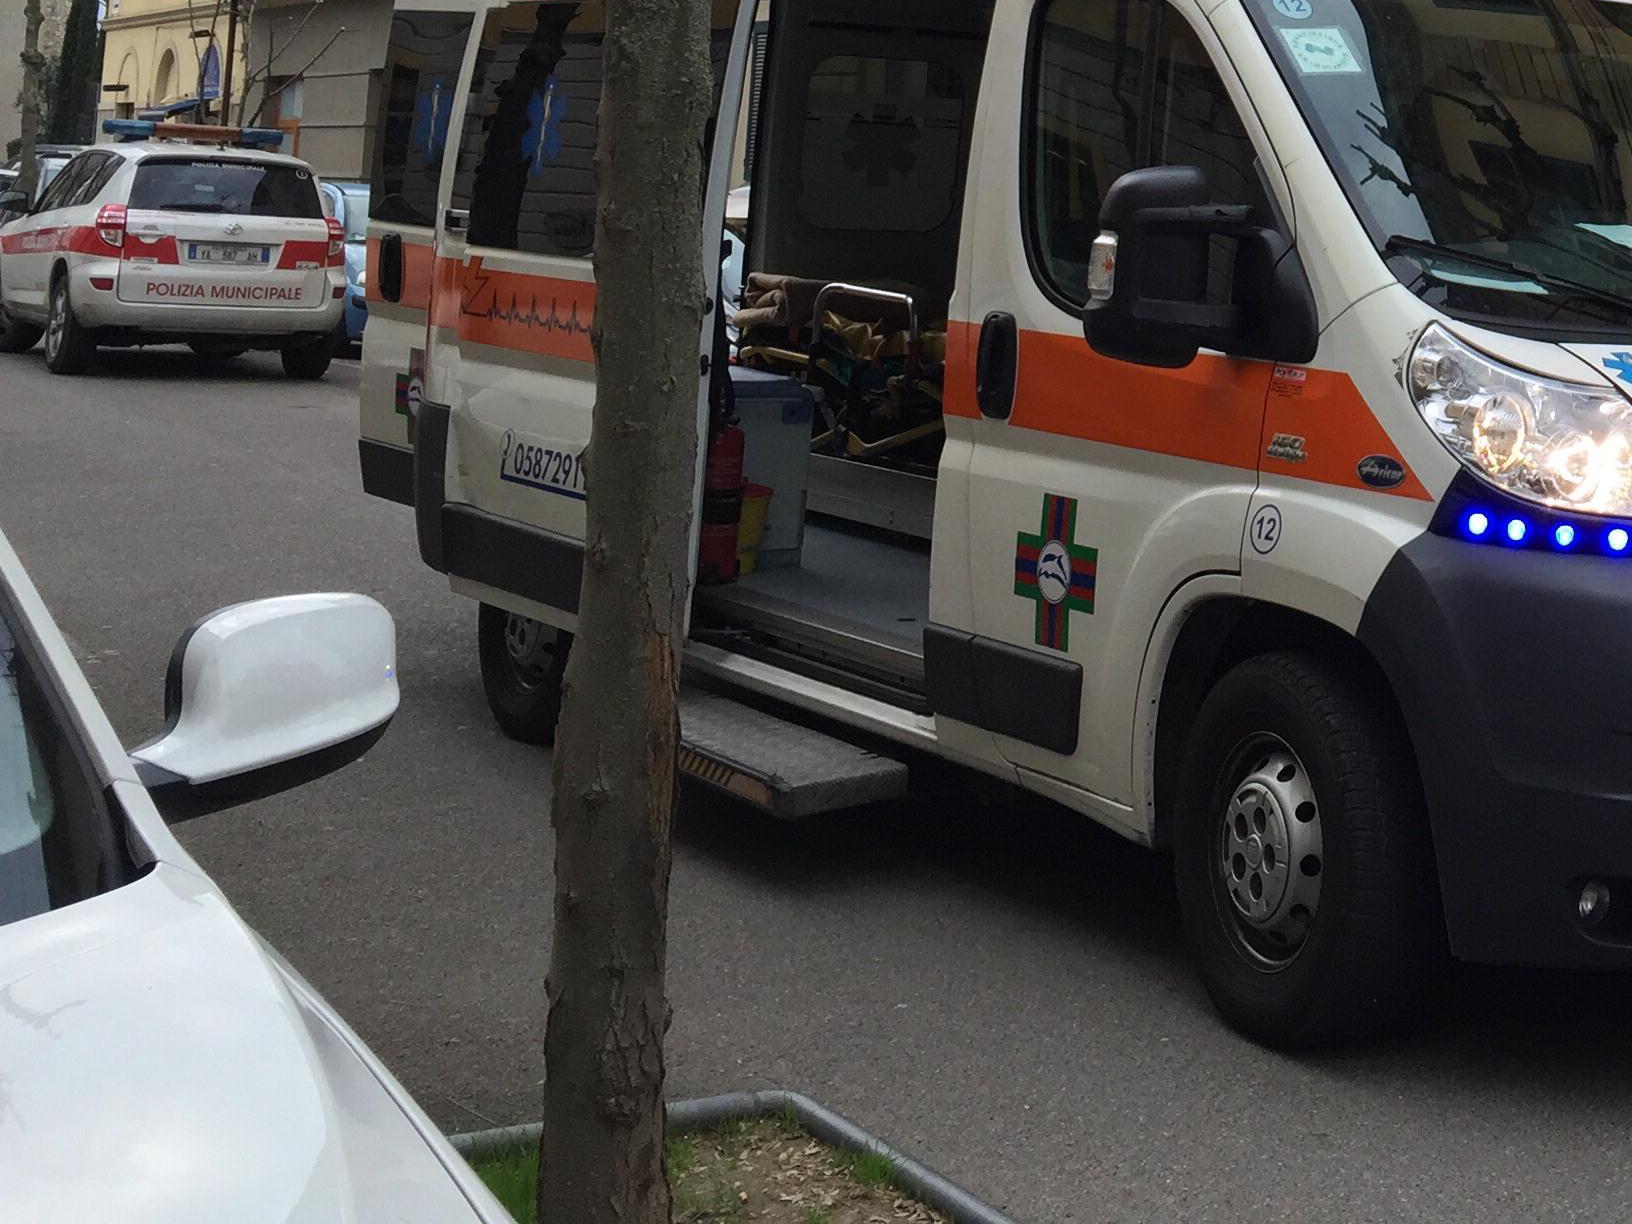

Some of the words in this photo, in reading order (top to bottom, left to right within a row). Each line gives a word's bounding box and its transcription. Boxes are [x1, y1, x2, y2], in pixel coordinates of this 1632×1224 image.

[145, 282, 205, 298] POLIZIA
[210, 285, 302, 300] MUNICIPALE
[1256, 518, 1277, 541] 12
